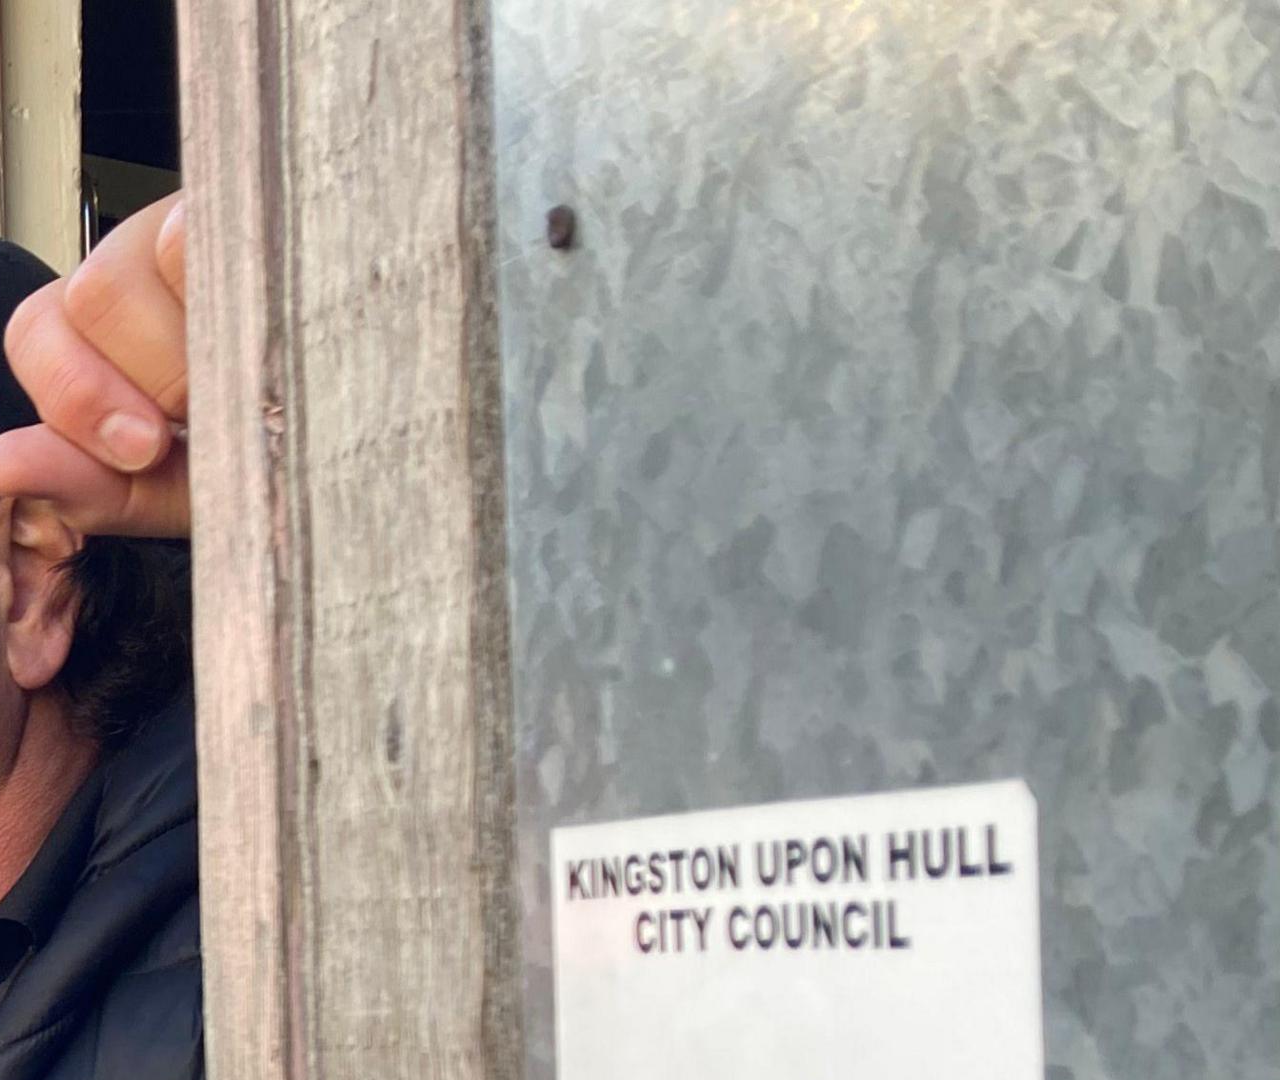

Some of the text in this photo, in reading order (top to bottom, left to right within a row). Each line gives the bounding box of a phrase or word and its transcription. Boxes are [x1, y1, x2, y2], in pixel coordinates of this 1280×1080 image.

[567, 823, 1013, 901] KINGSTON UPON HULL
[635, 899, 911, 954] CITY COUNCIL
